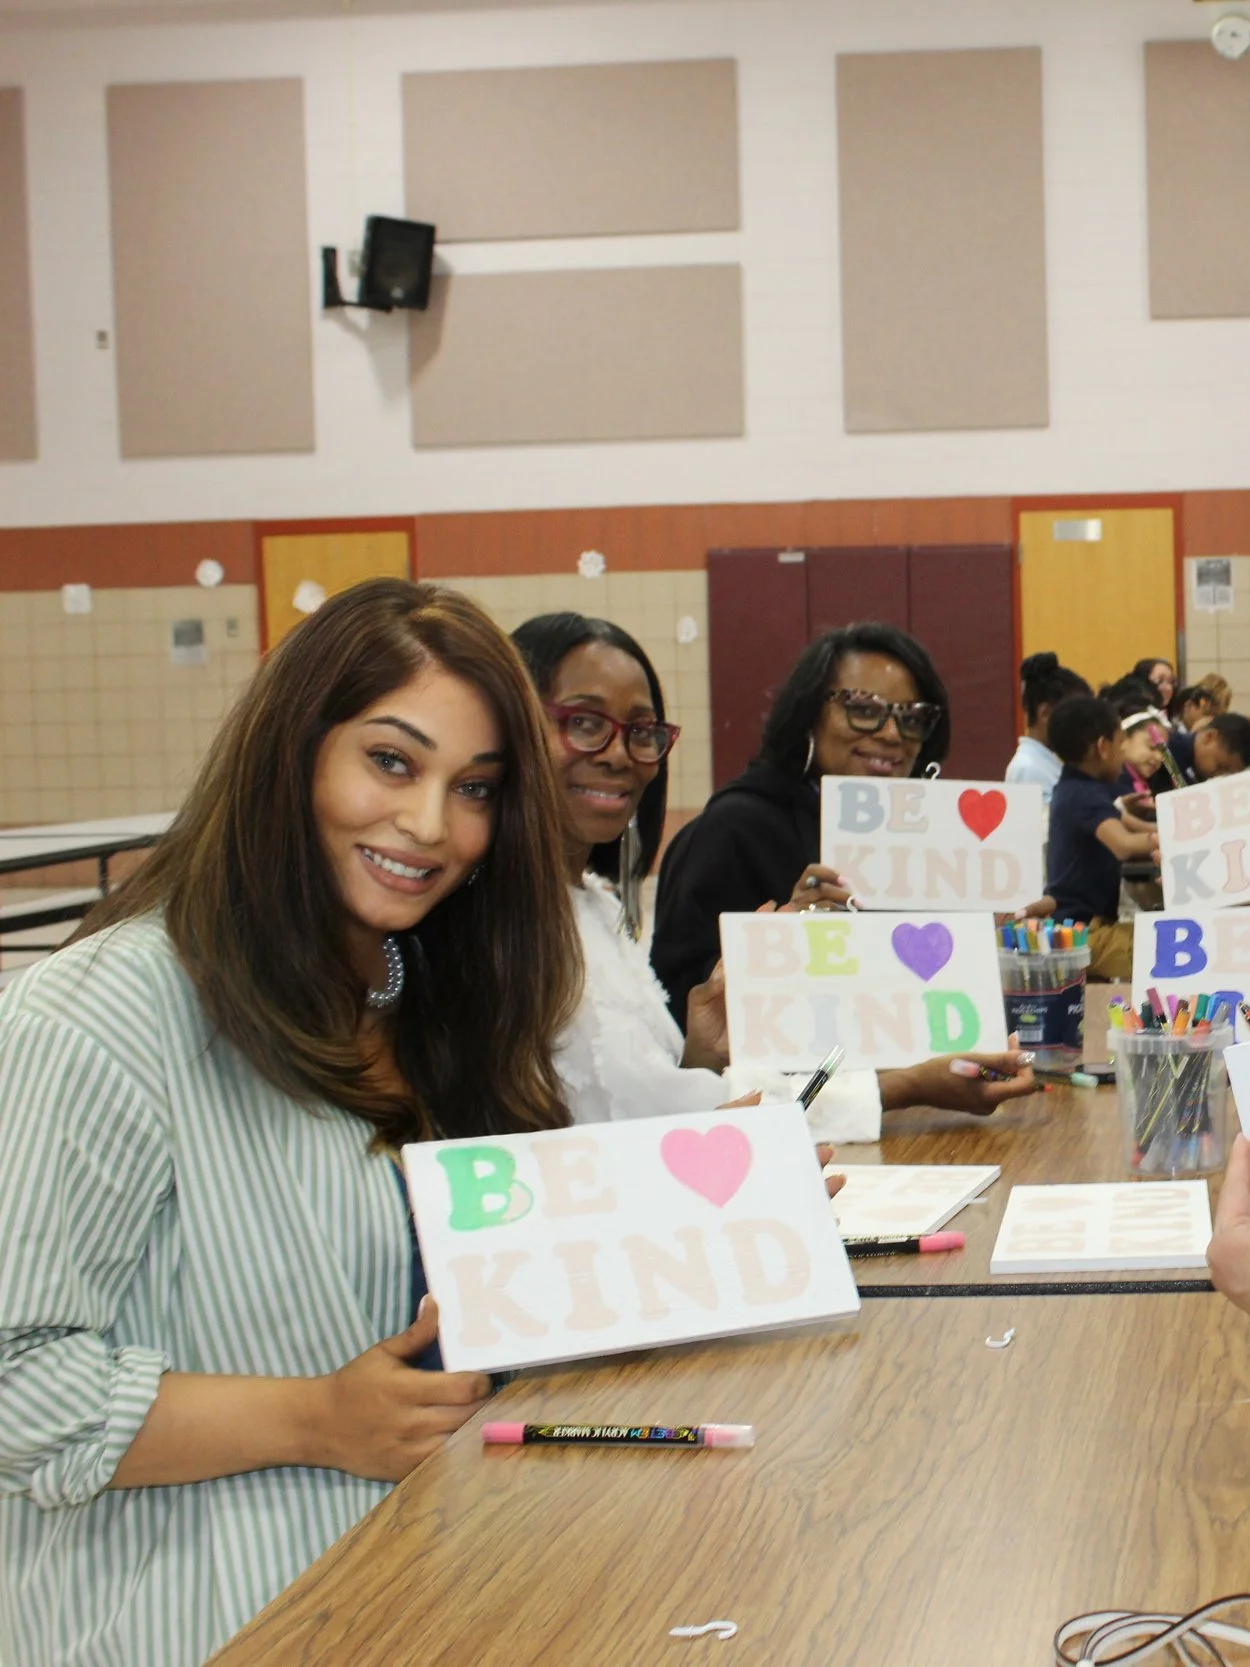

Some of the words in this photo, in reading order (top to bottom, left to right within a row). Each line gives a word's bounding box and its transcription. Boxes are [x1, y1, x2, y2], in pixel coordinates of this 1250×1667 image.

[837, 782, 930, 834] BE
[831, 844, 1023, 899] KIND
[742, 919, 859, 978] BE
[740, 989, 981, 1055] KIND
[435, 1137, 617, 1233] BE
[447, 1218, 812, 1349] KIND
